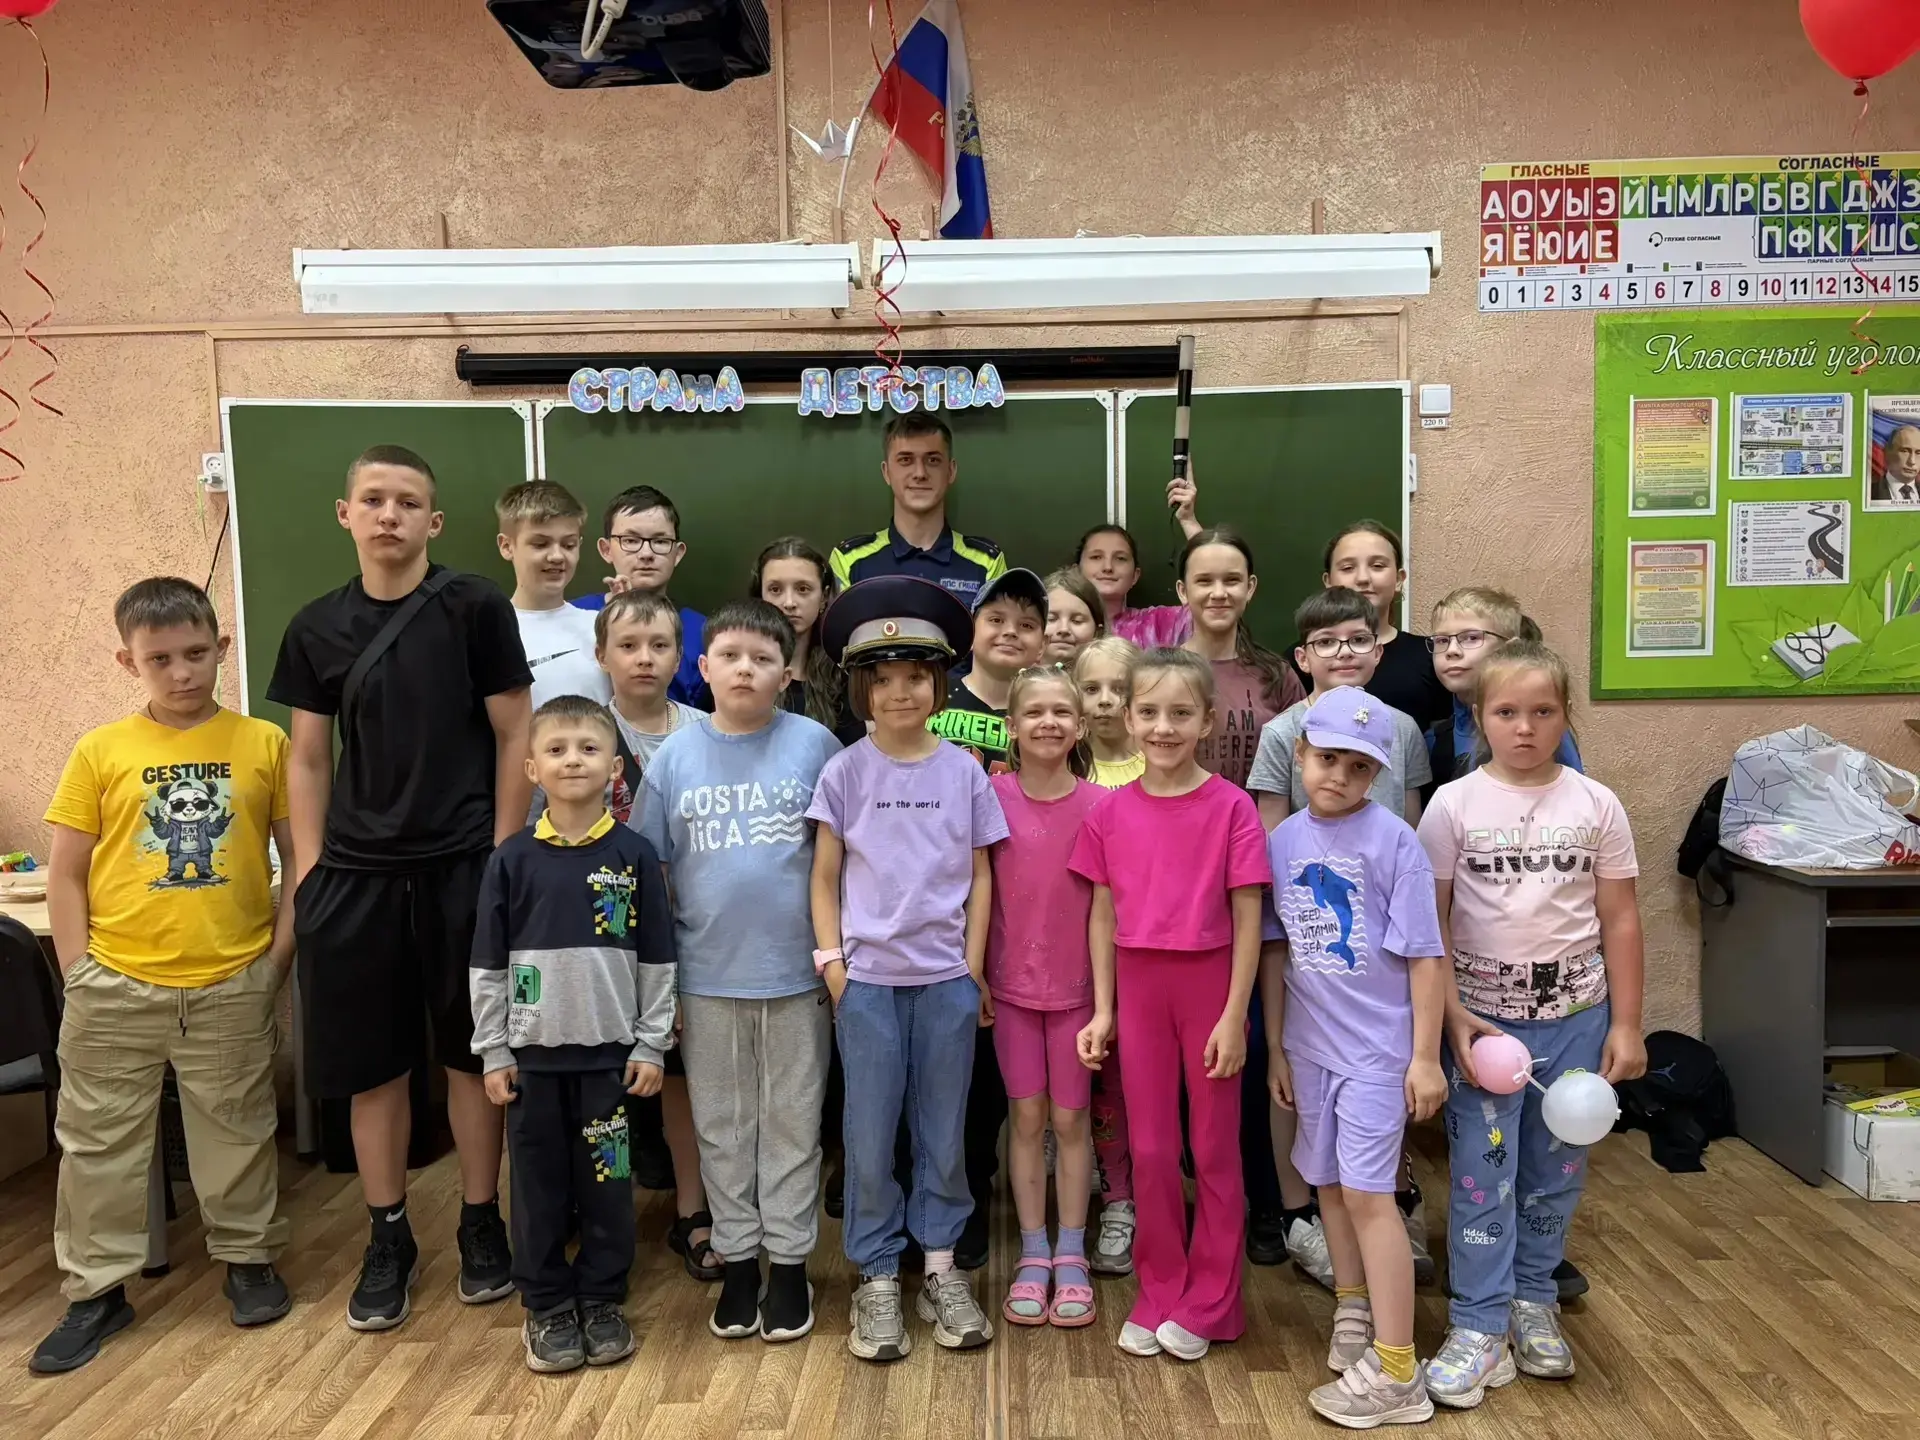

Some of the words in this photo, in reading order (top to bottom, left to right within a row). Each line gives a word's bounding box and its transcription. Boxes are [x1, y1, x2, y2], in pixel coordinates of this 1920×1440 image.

[1511, 163, 1590, 177] ГЛАСНЫЕ
[1779, 155, 1880, 170] СОГЛАСНЫЕ
[1488, 287, 1499, 304] 0
[1517, 286, 1526, 303] 1
[1543, 285, 1554, 302] 2
[1571, 284, 1582, 301] 3
[1599, 283, 1610, 300] 4
[1627, 282, 1638, 300] 5
[1654, 281, 1666, 299] 6
[1683, 281, 1694, 298] 7
[1710, 280, 1721, 297] 8
[1738, 279, 1749, 296] 9
[1760, 278, 1782, 296] 10
[1790, 278, 1808, 295] 11
[1816, 277, 1836, 294] 12
[1843, 276, 1864, 294] 13
[1872, 275, 1891, 293] 14
[1898, 275, 1919, 292] 15
[1645, 333, 1818, 374] Классный
[568, 365, 746, 413] СТРАНА
[798, 363, 1006, 418] ДЕТСТВА
[1226, 710, 1254, 732] AM
[142, 762, 231, 785] GESTURE
[680, 781, 768, 819] COSTA
[896, 800, 911, 808] the
[915, 800, 940, 809] world
[589, 872, 638, 887] MINECRAFT
[1292, 916, 1295, 924] I
[1298, 908, 1321, 924] NEED
[1302, 940, 1322, 955] SEA
[512, 1007, 540, 1018] RAFTING
